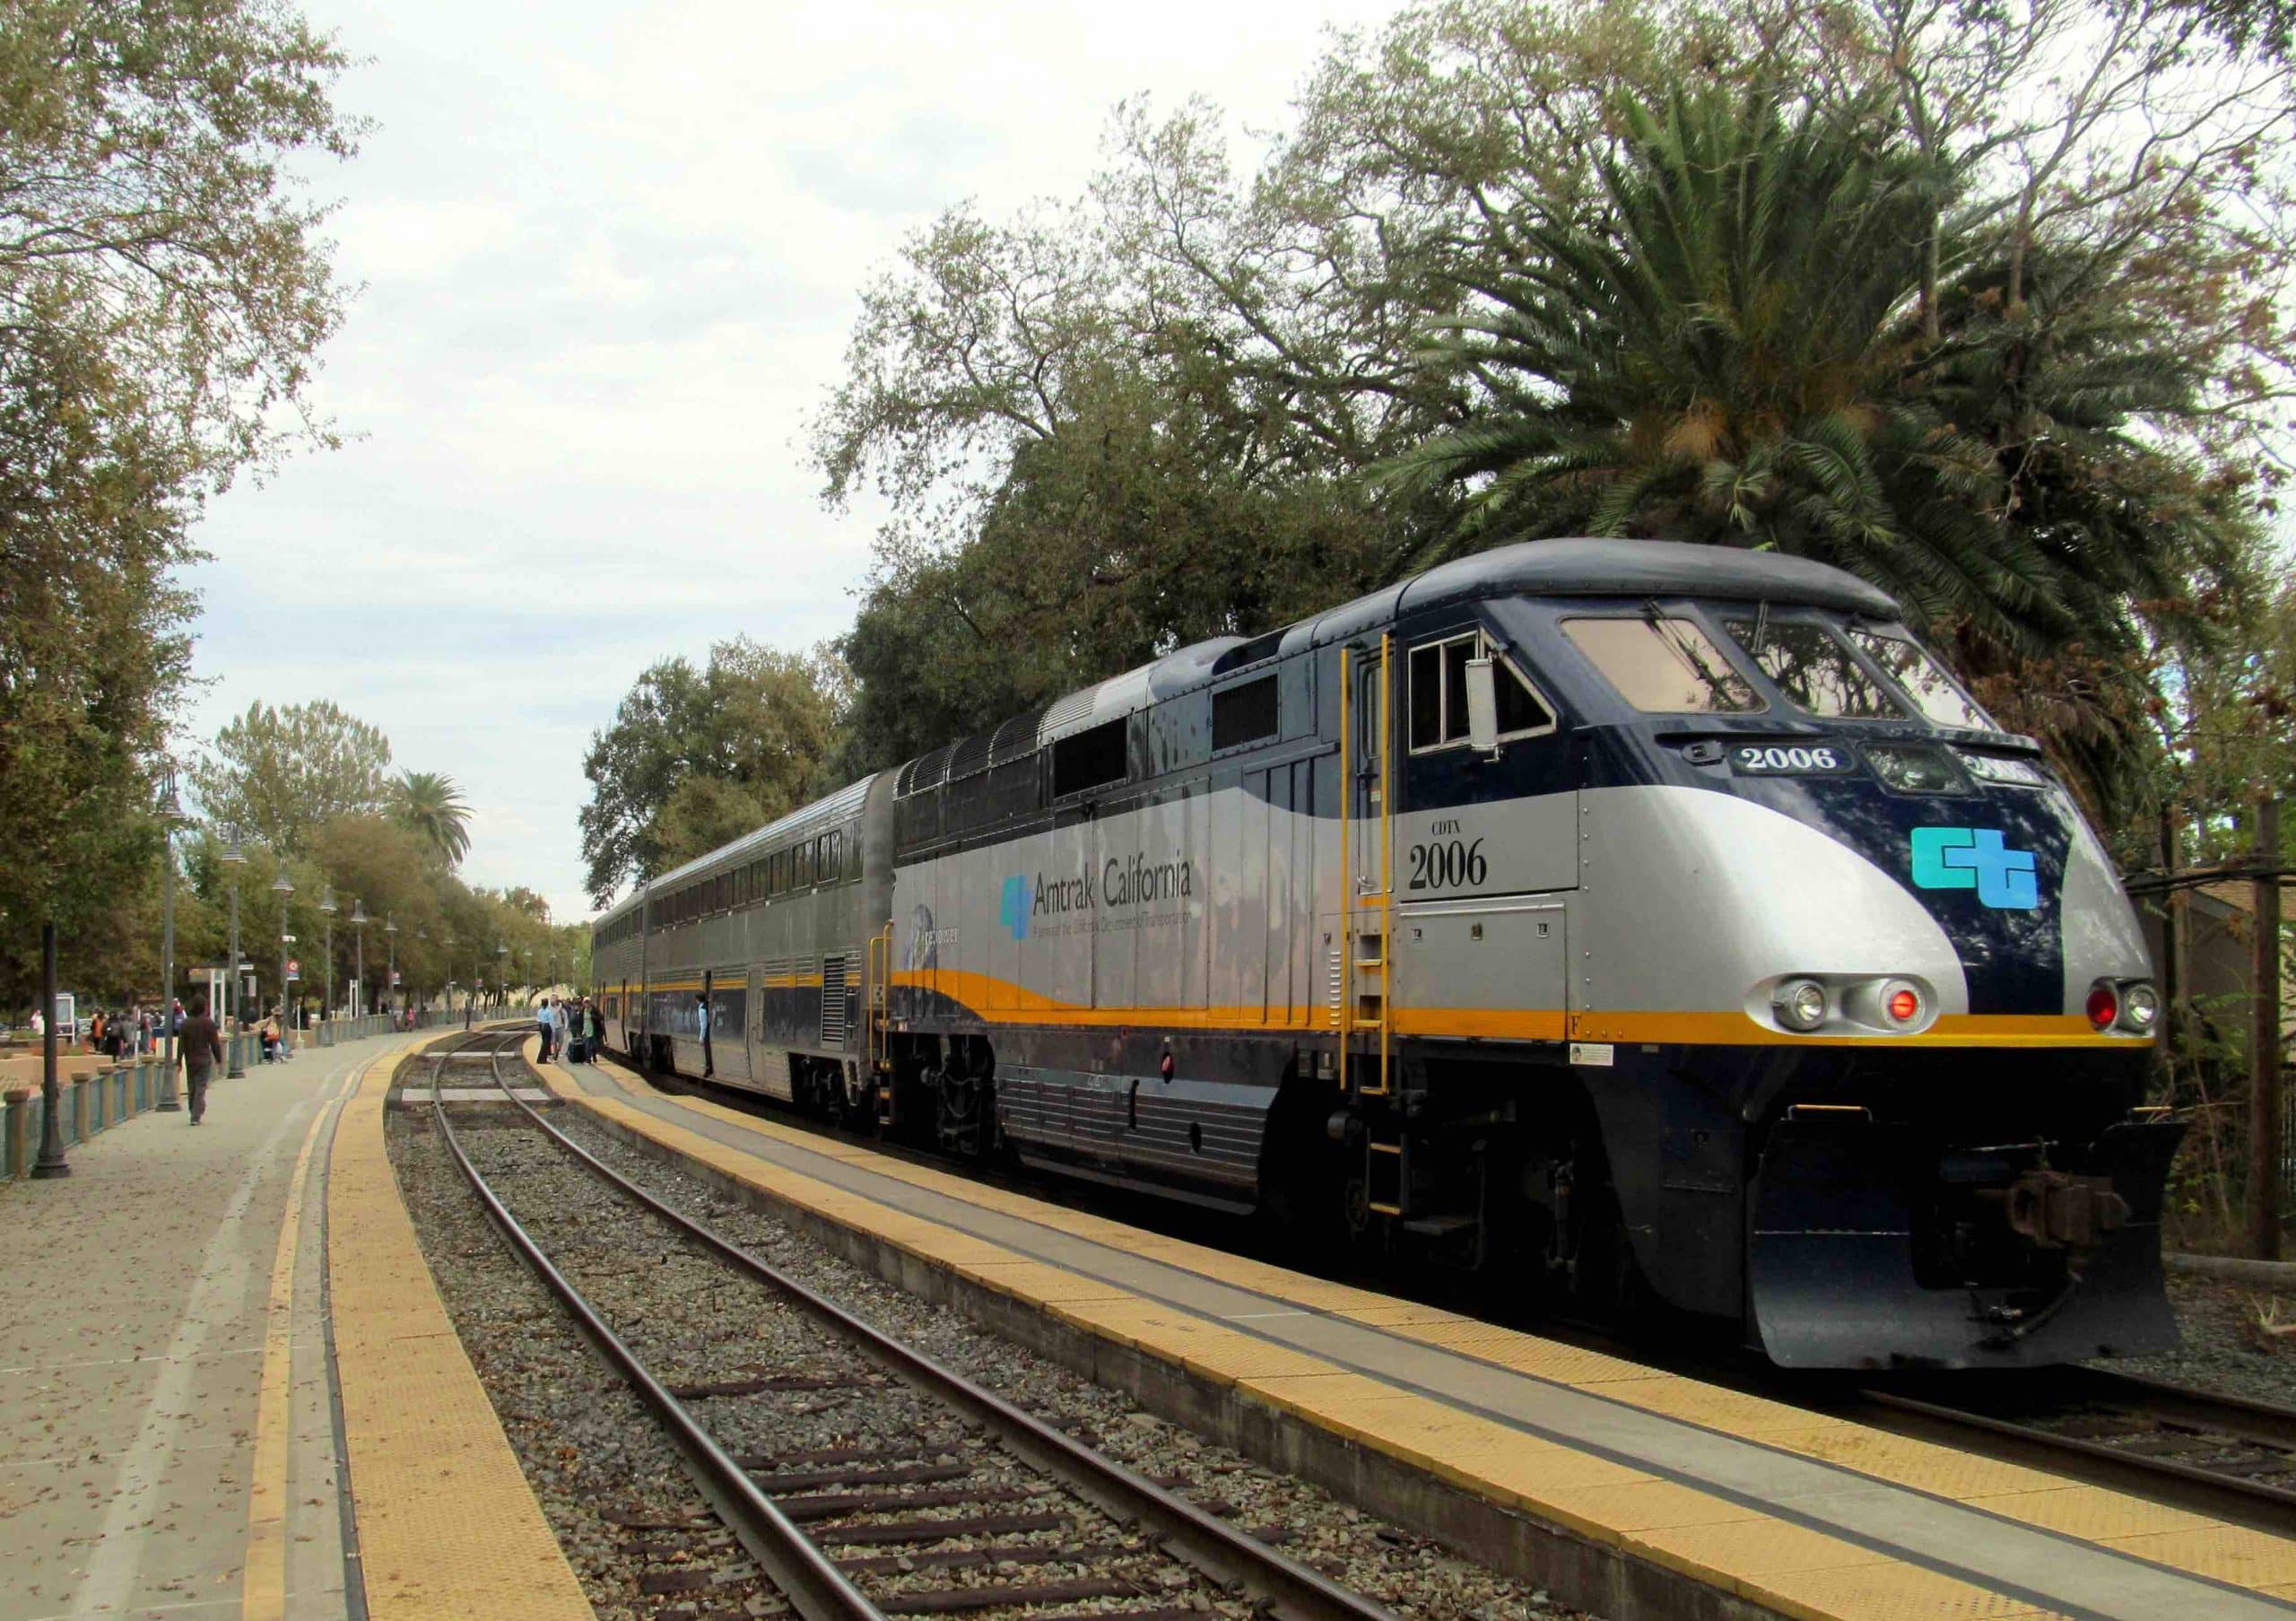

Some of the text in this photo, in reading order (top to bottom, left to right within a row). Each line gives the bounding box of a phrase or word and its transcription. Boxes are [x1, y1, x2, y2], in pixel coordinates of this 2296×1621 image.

[1740, 747, 1837, 769] 2006
[1431, 819, 1460, 835] CDTX
[1409, 838, 1487, 890] 2006
[1033, 849, 1192, 917] Amtrak California
